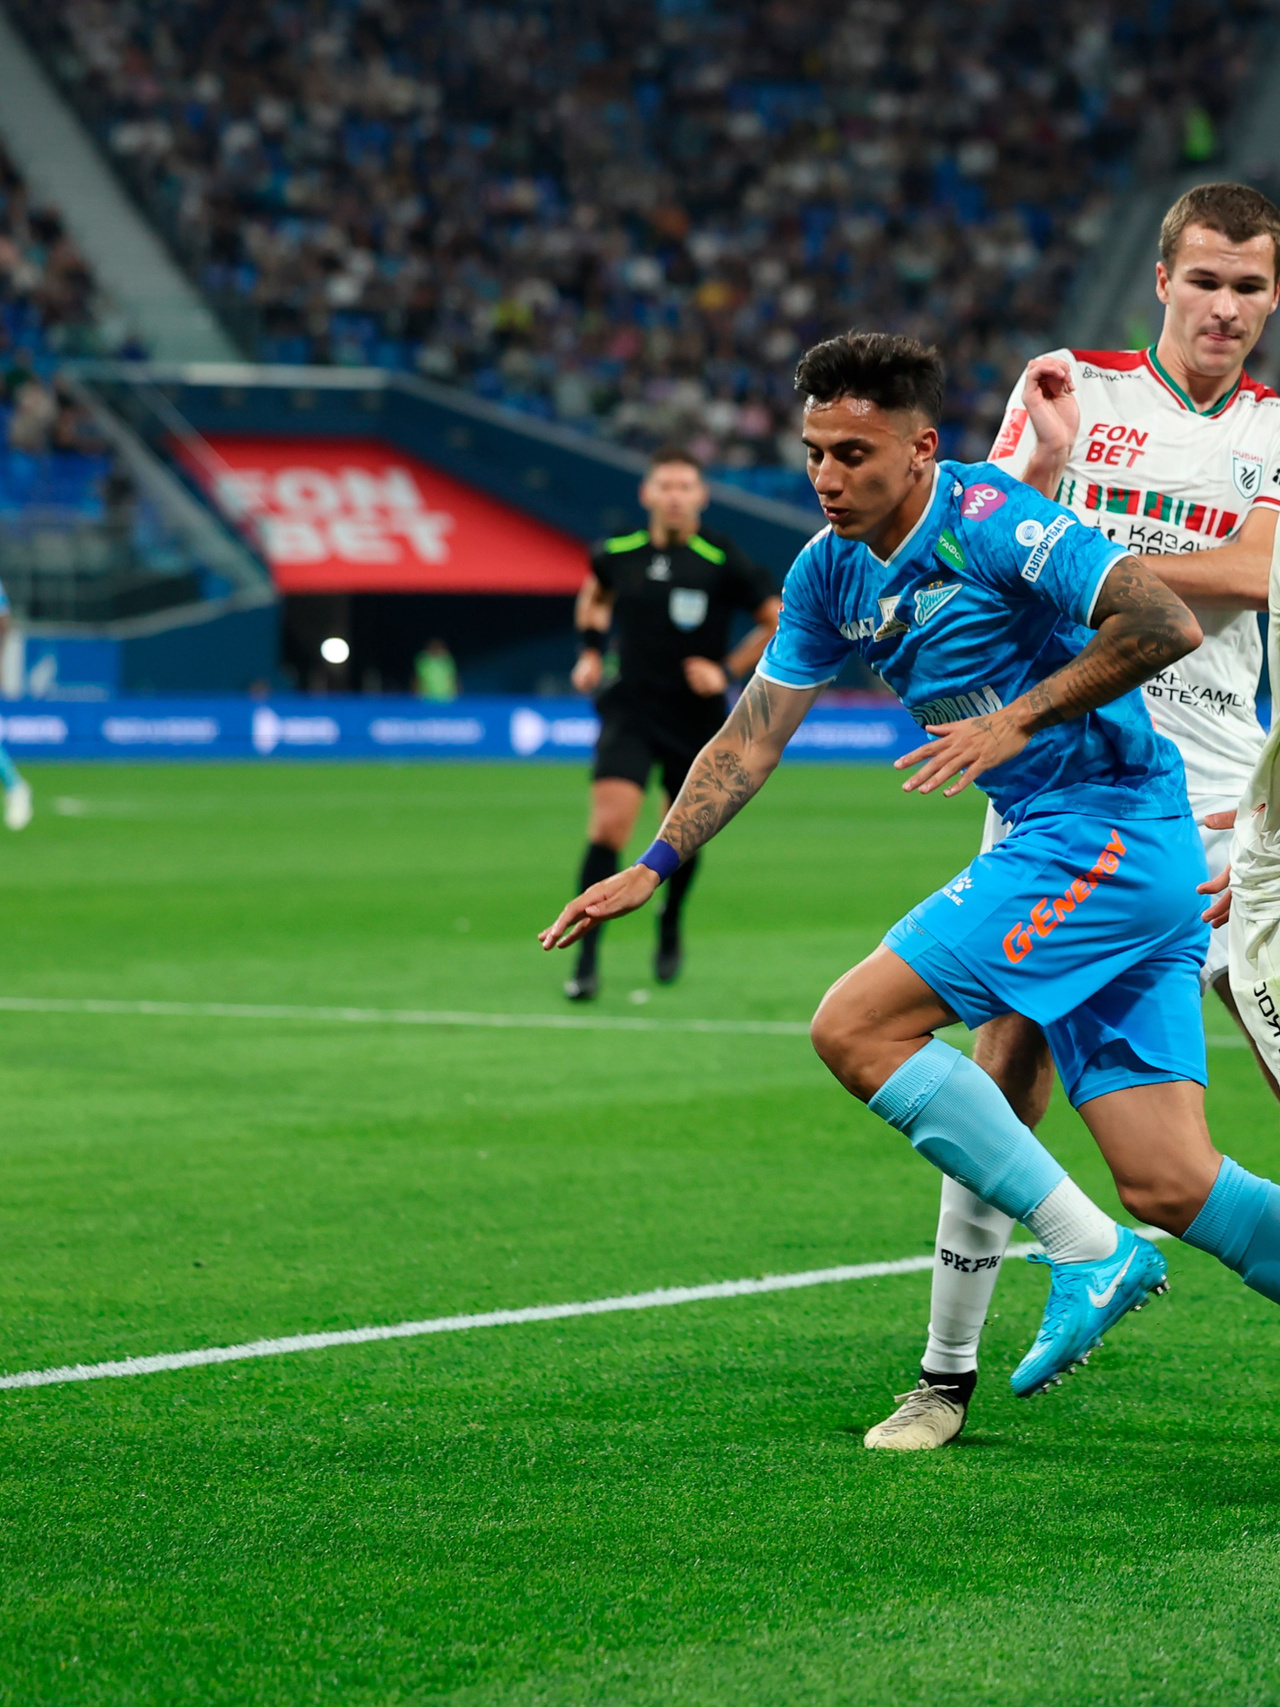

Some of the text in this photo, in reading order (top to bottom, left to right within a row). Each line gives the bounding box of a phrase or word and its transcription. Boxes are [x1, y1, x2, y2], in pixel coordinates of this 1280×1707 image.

[1088, 423, 1149, 447] FON
[1085, 441, 1145, 468] BET
[214, 467, 423, 522] FON
[964, 488, 998, 514] wb
[258, 512, 454, 564] BET
[939, 535, 964, 564] ГАФО
[1129, 524, 1210, 551] КАЗА
[941, 1248, 1001, 1272] ФКРК
